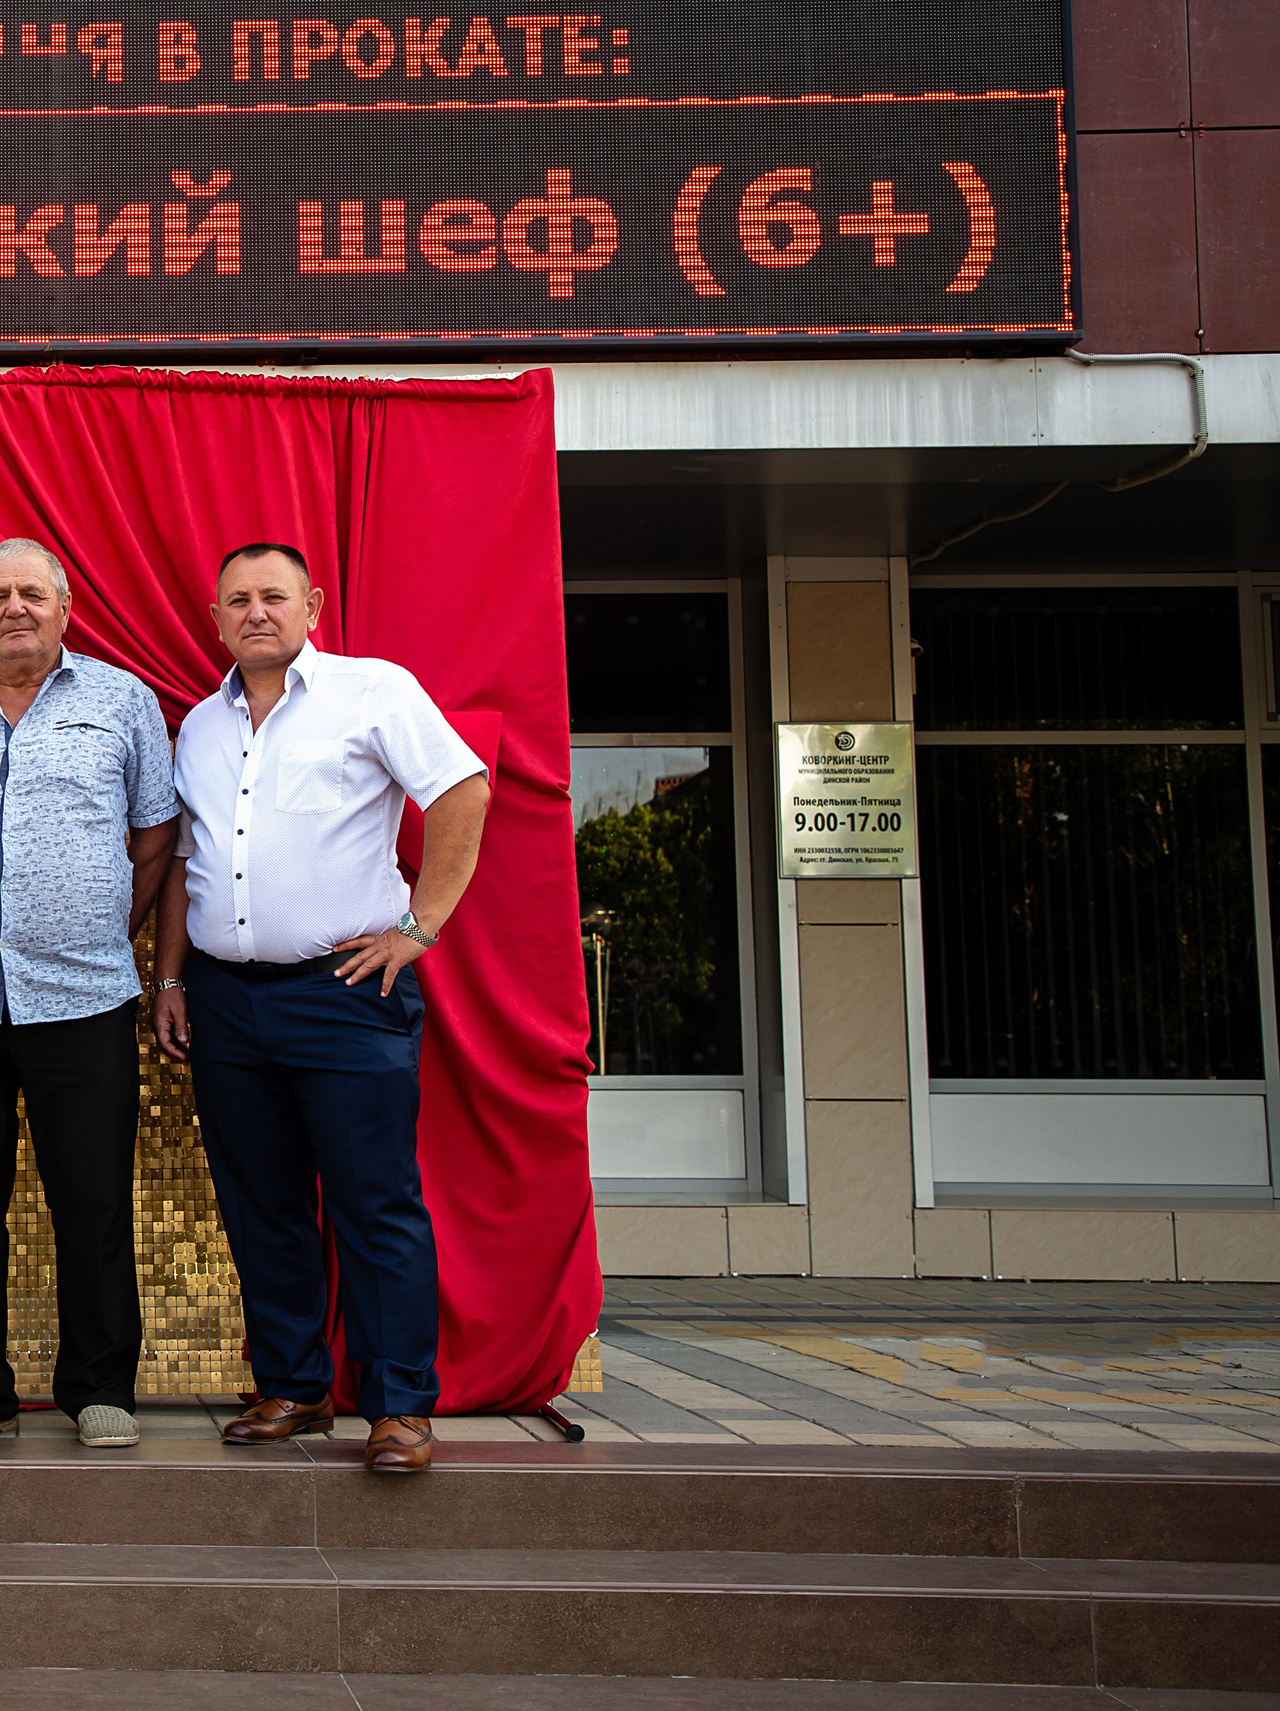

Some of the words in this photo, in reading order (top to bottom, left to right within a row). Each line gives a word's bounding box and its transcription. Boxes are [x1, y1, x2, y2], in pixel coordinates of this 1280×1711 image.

[158, 21, 202, 82] В
[232, 15, 631, 81] ПРОКАТЕ:
[298, 168, 619, 298] шеф
[672, 162, 996, 296] (6+)
[802, 755, 890, 766] КОВОРКИНГ-ЦЕНТР
[823, 776, 850, 784] ДИНСКОЙ
[793, 796, 902, 807] Понедельник-Пятница
[794, 812, 902, 832] 9.00-17.00
